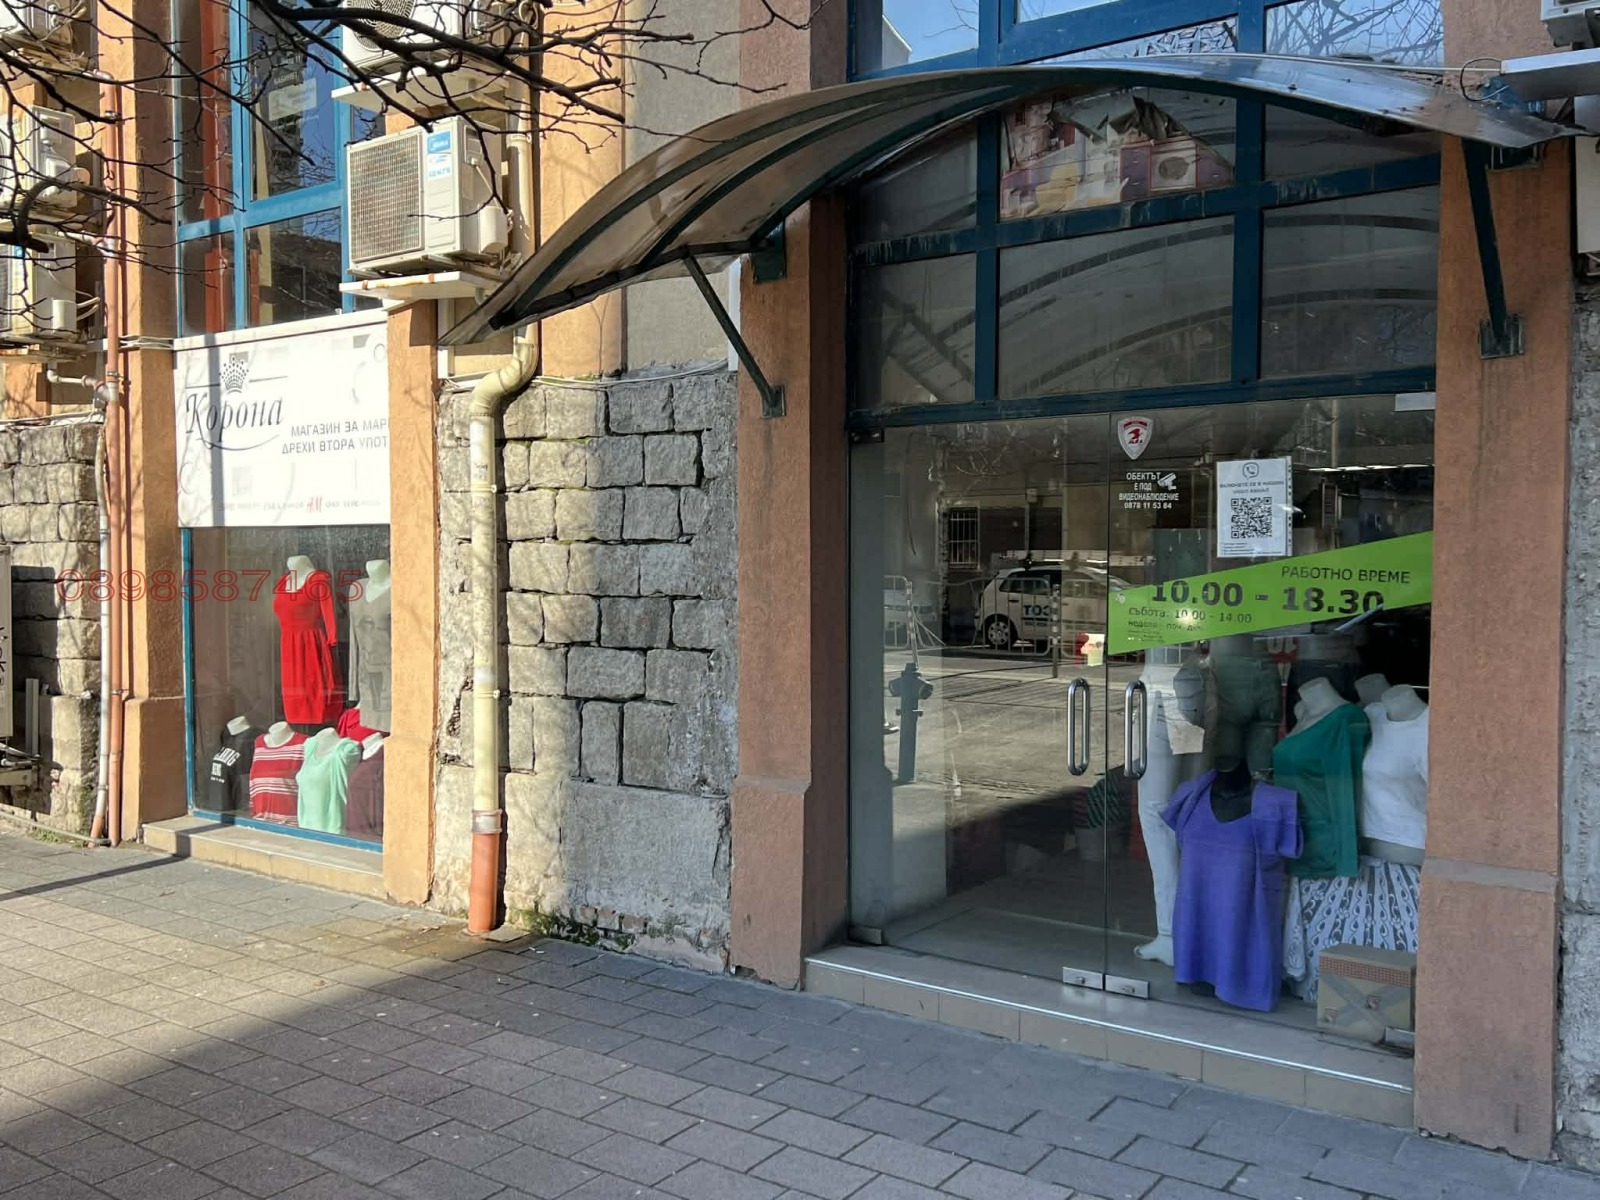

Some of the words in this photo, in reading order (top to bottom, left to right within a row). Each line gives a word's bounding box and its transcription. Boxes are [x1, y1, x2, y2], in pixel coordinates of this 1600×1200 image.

[185, 393, 283, 446] Корона
[291, 422, 341, 438] МАГАЗИН
[344, 420, 359, 433] ЗА
[363, 418, 389, 431] МАР
[282, 441, 316, 454] ДРЕХИ
[319, 438, 355, 452] ВТОРА
[1126, 472, 1161, 480] ОБЕКТЪТ
[1134, 482, 1139, 490] Е
[1139, 482, 1152, 491] ПОД
[1118, 492, 1179, 501] ВИДЕОНАБЛЮДЕНИЕ
[1281, 566, 1353, 581] РАБОТНО
[1358, 569, 1411, 584] ВРЕМЕ
[1152, 580, 1244, 606] 10.00
[1282, 586, 1385, 615] 18.30
